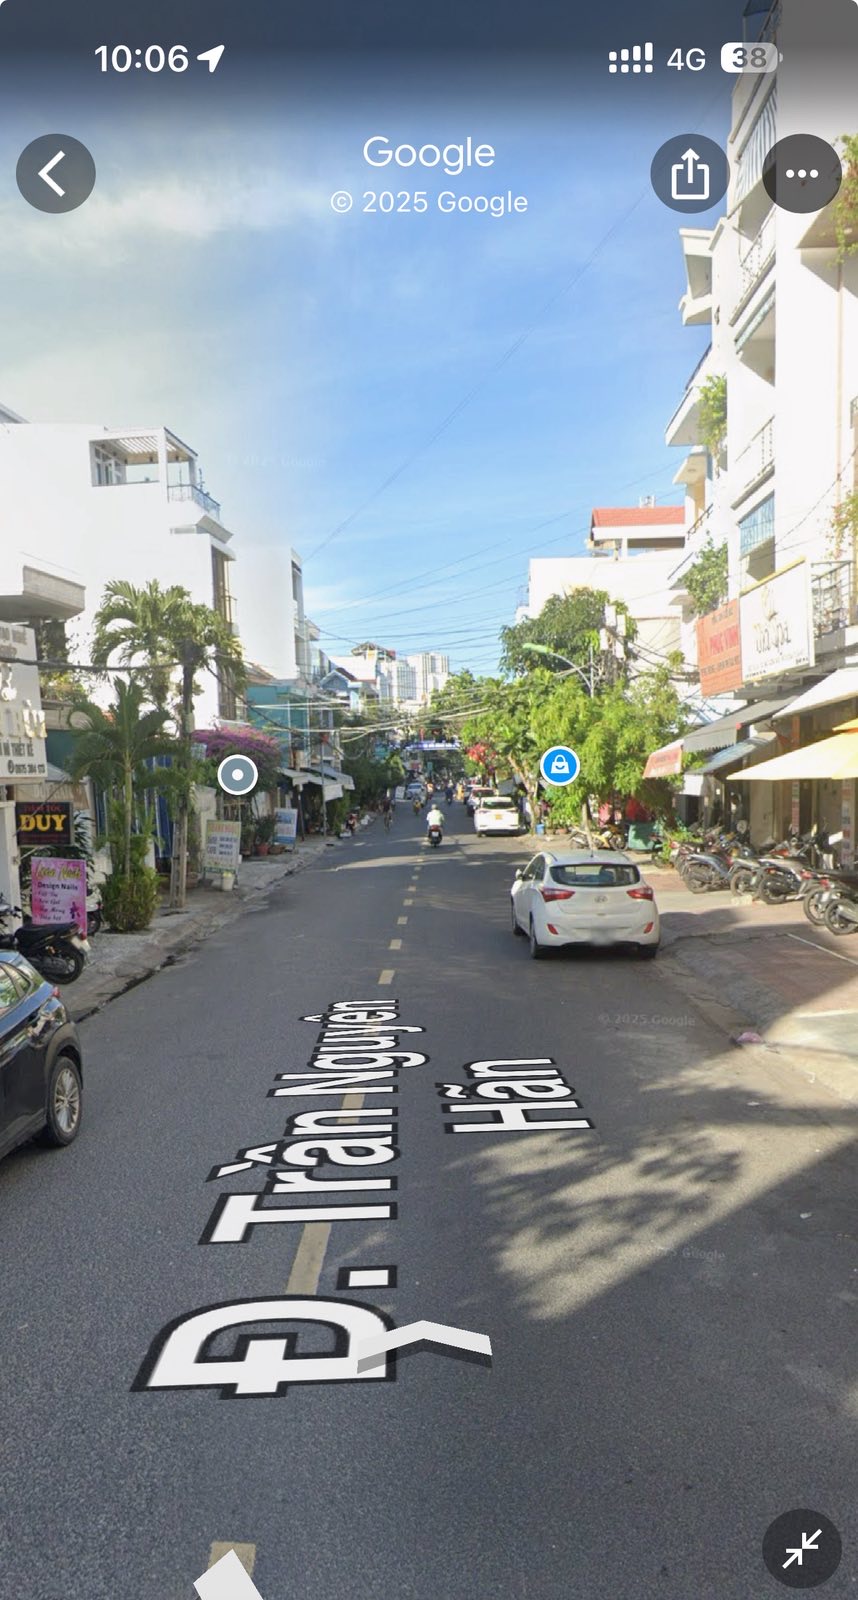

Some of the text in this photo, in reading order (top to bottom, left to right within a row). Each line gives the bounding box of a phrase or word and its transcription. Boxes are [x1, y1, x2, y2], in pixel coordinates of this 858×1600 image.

[19, 814, 67, 832] DUY
[37, 882, 78, 891] Design Nails
